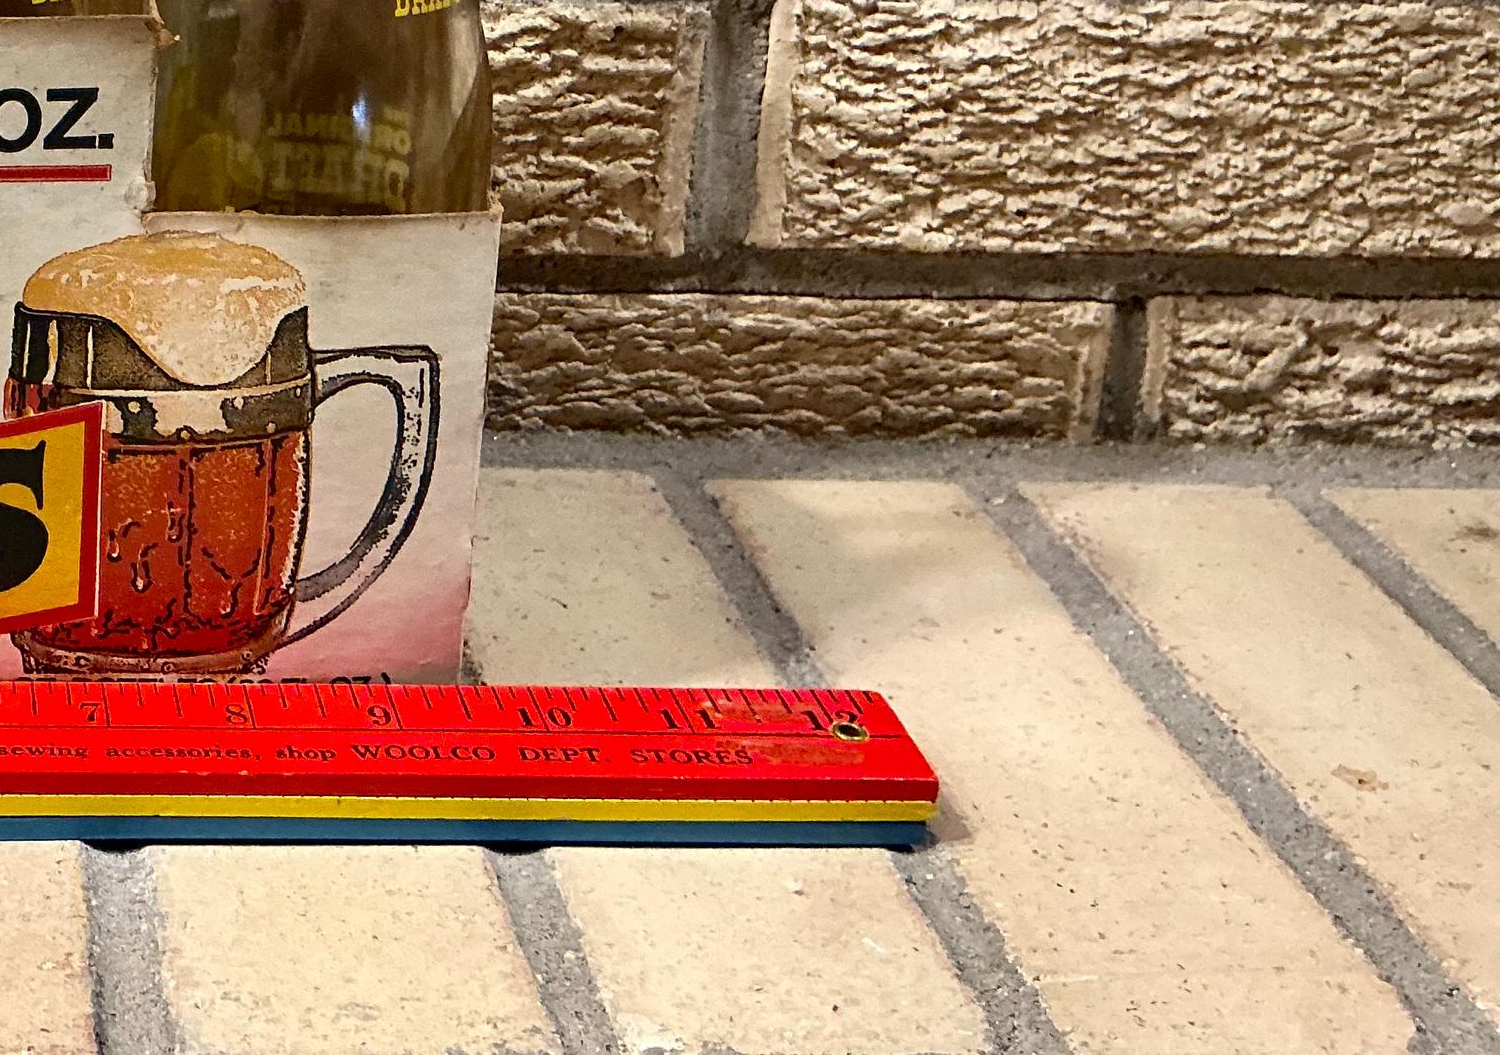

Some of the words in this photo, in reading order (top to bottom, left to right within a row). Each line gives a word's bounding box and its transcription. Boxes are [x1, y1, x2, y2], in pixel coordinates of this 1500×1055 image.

[78, 702, 100, 723] 7
[225, 704, 248, 725] 8
[366, 705, 392, 726] 9
[106, 744, 262, 761] accessories,
[275, 744, 337, 762] shop
[351, 744, 496, 761] WOOLCO
[631, 748, 754, 766] STORES
